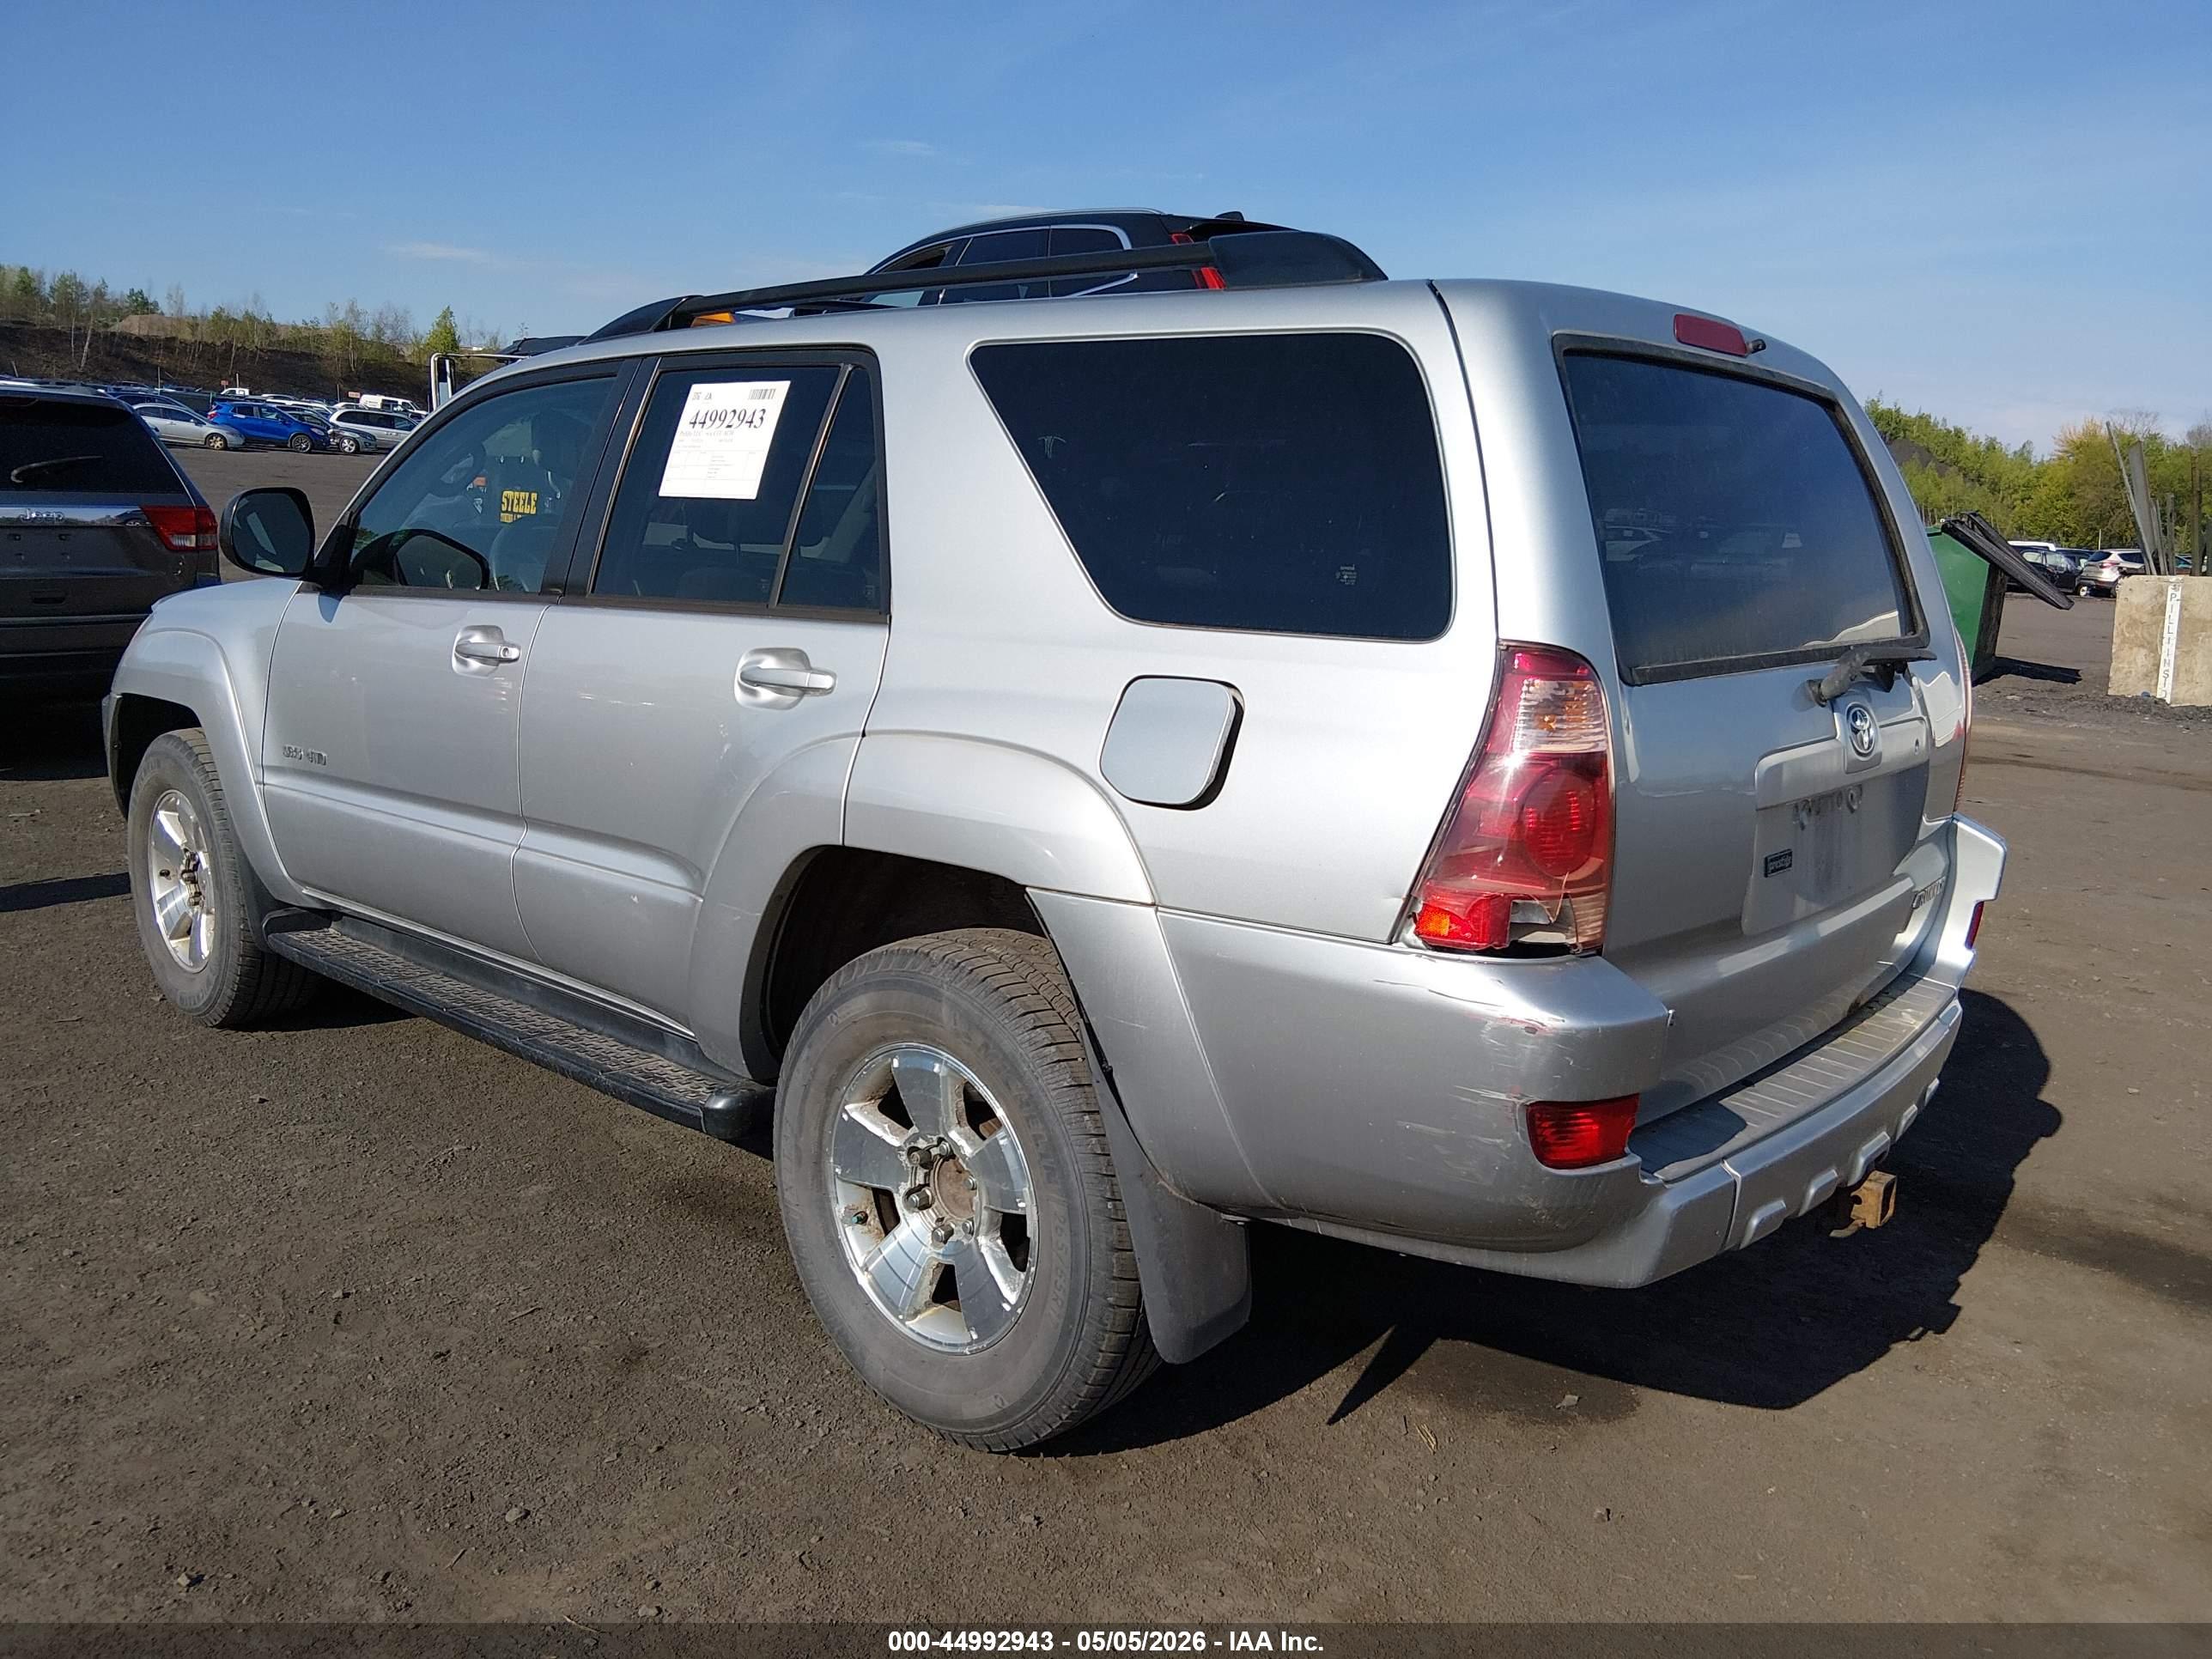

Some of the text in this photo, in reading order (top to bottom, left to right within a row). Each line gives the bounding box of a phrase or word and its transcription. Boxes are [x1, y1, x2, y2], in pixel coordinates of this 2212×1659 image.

[689, 408, 766, 430] 44992943
[501, 490, 538, 514] STEELE
[20, 508, 64, 523] Jeep
